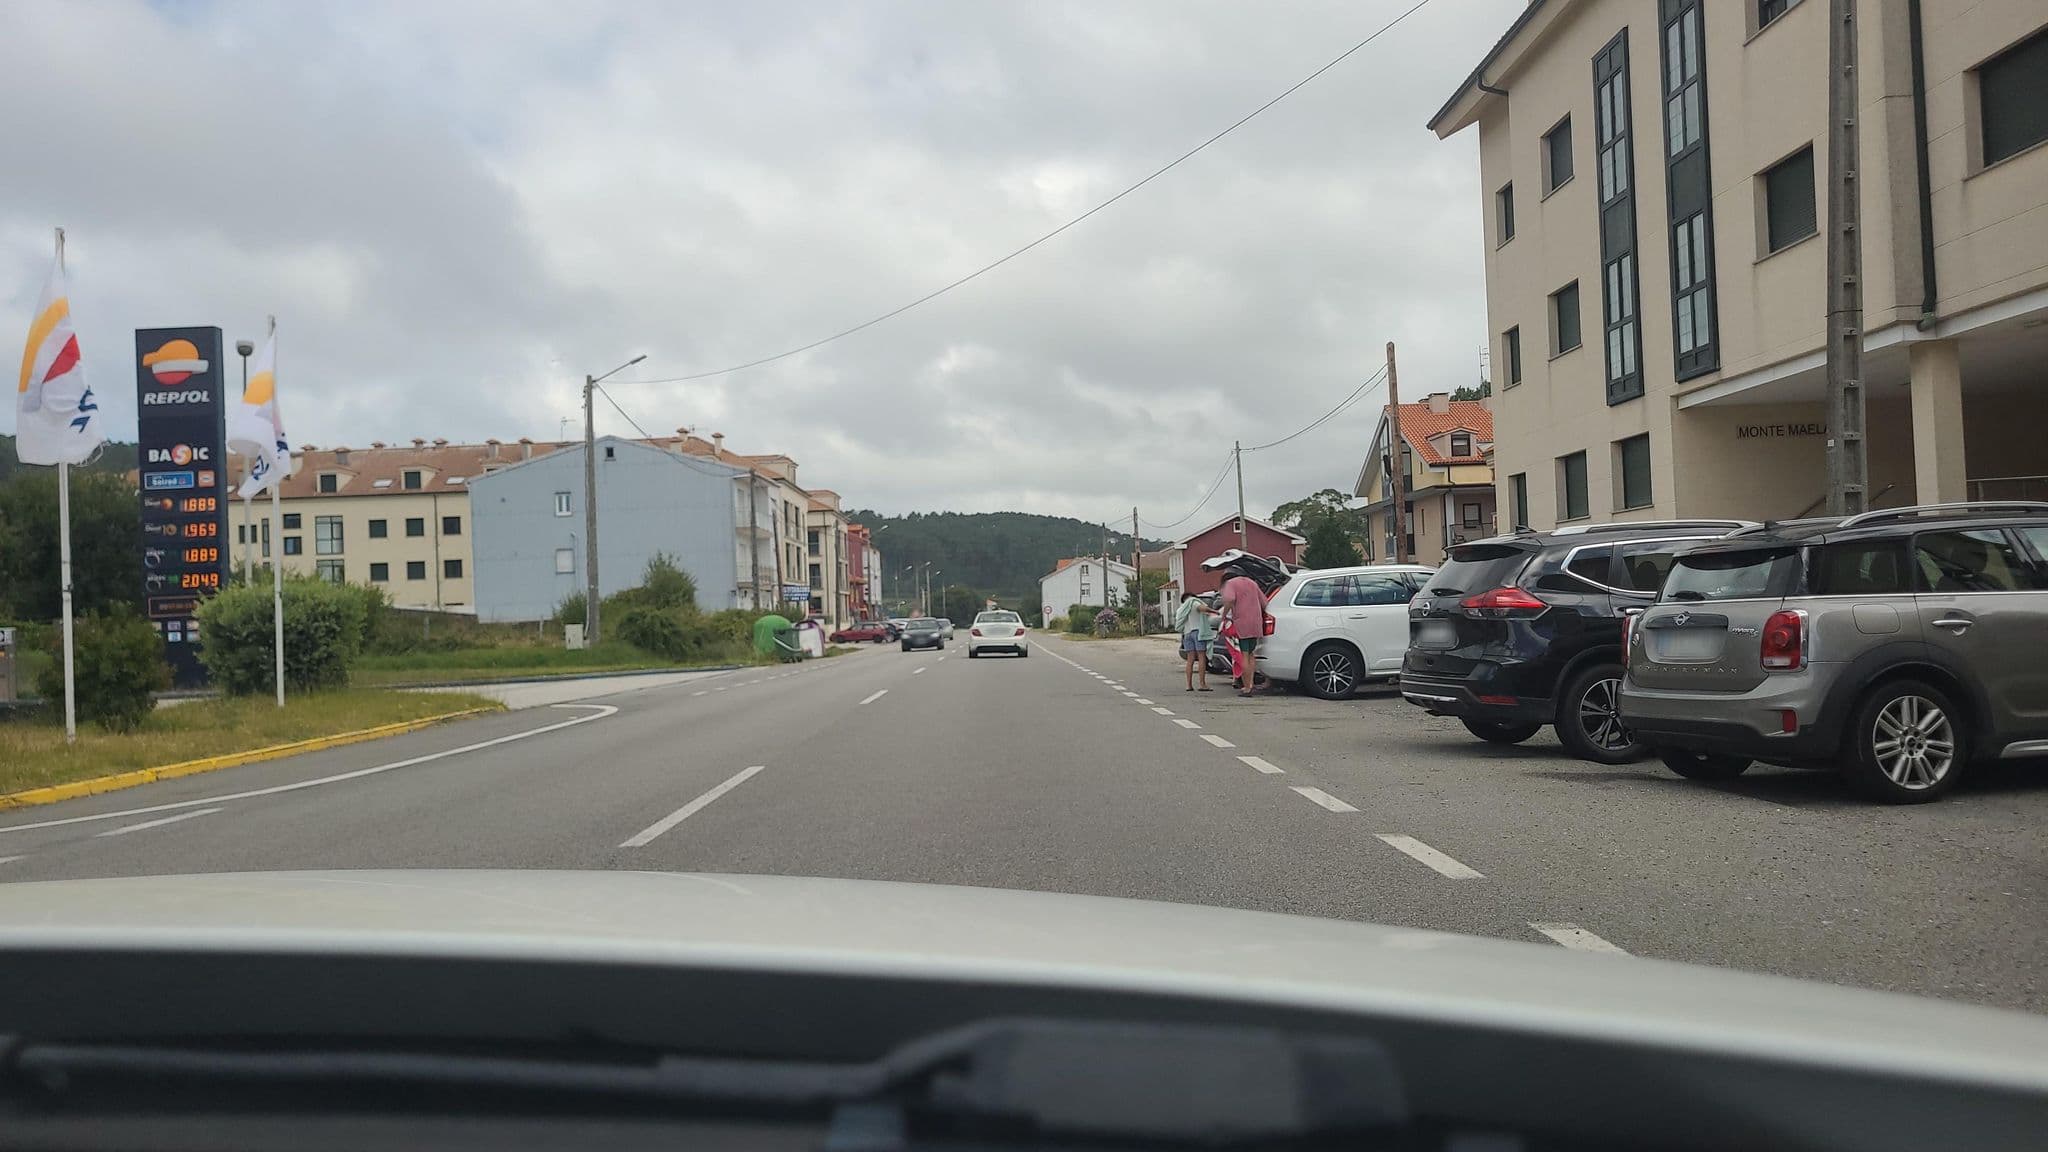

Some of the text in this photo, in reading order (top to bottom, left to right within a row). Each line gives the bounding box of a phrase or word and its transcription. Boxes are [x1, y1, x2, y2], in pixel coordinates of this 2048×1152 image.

[143, 391, 210, 405] REPSOL
[1738, 425, 1784, 438] MONTE
[148, 446, 209, 463] BASIC
[184, 523, 217, 537] 1.969
